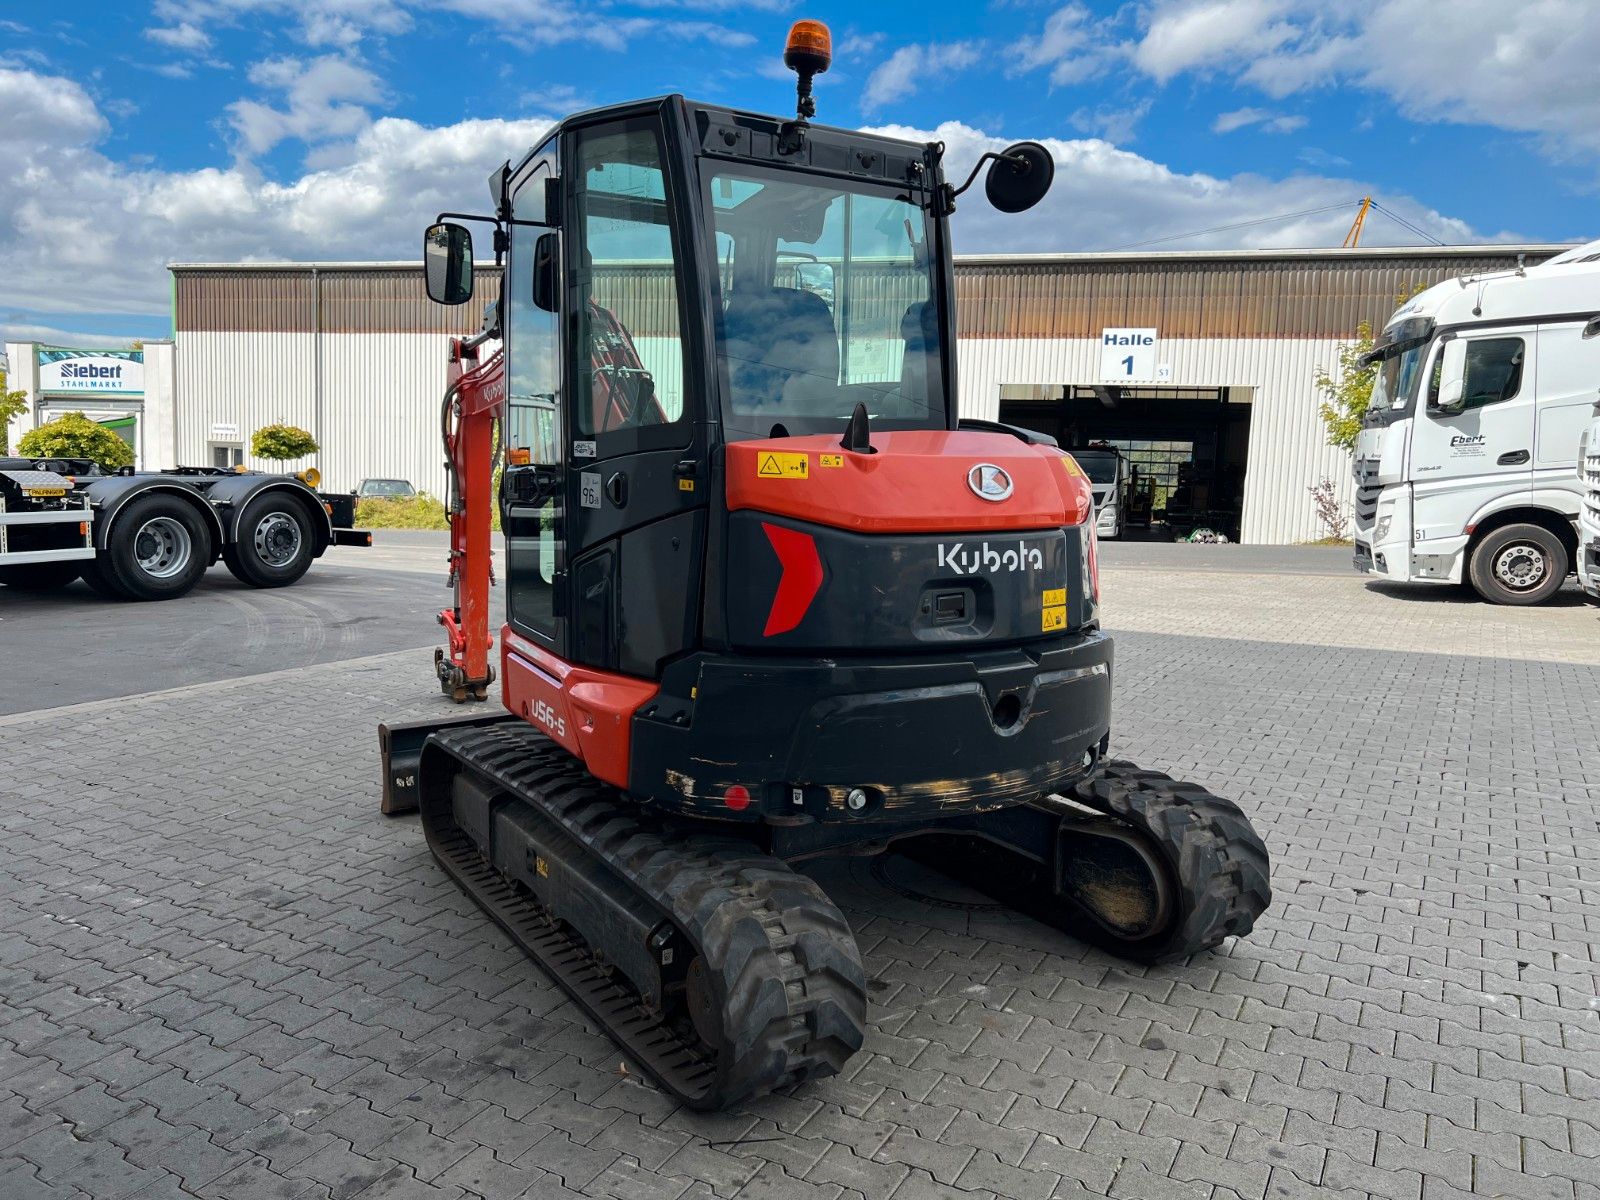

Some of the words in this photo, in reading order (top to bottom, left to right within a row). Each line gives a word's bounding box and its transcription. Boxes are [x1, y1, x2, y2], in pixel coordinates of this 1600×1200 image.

[1104, 334, 1154, 346] Halle
[61, 363, 122, 378] Siebert
[1121, 355, 1134, 375] 1
[61, 380, 122, 388] STAHLMARKT
[1450, 434, 1486, 447] Ebert
[582, 487, 595, 505] 96
[1415, 529, 1426, 540] 51
[937, 540, 1043, 575] Kubota
